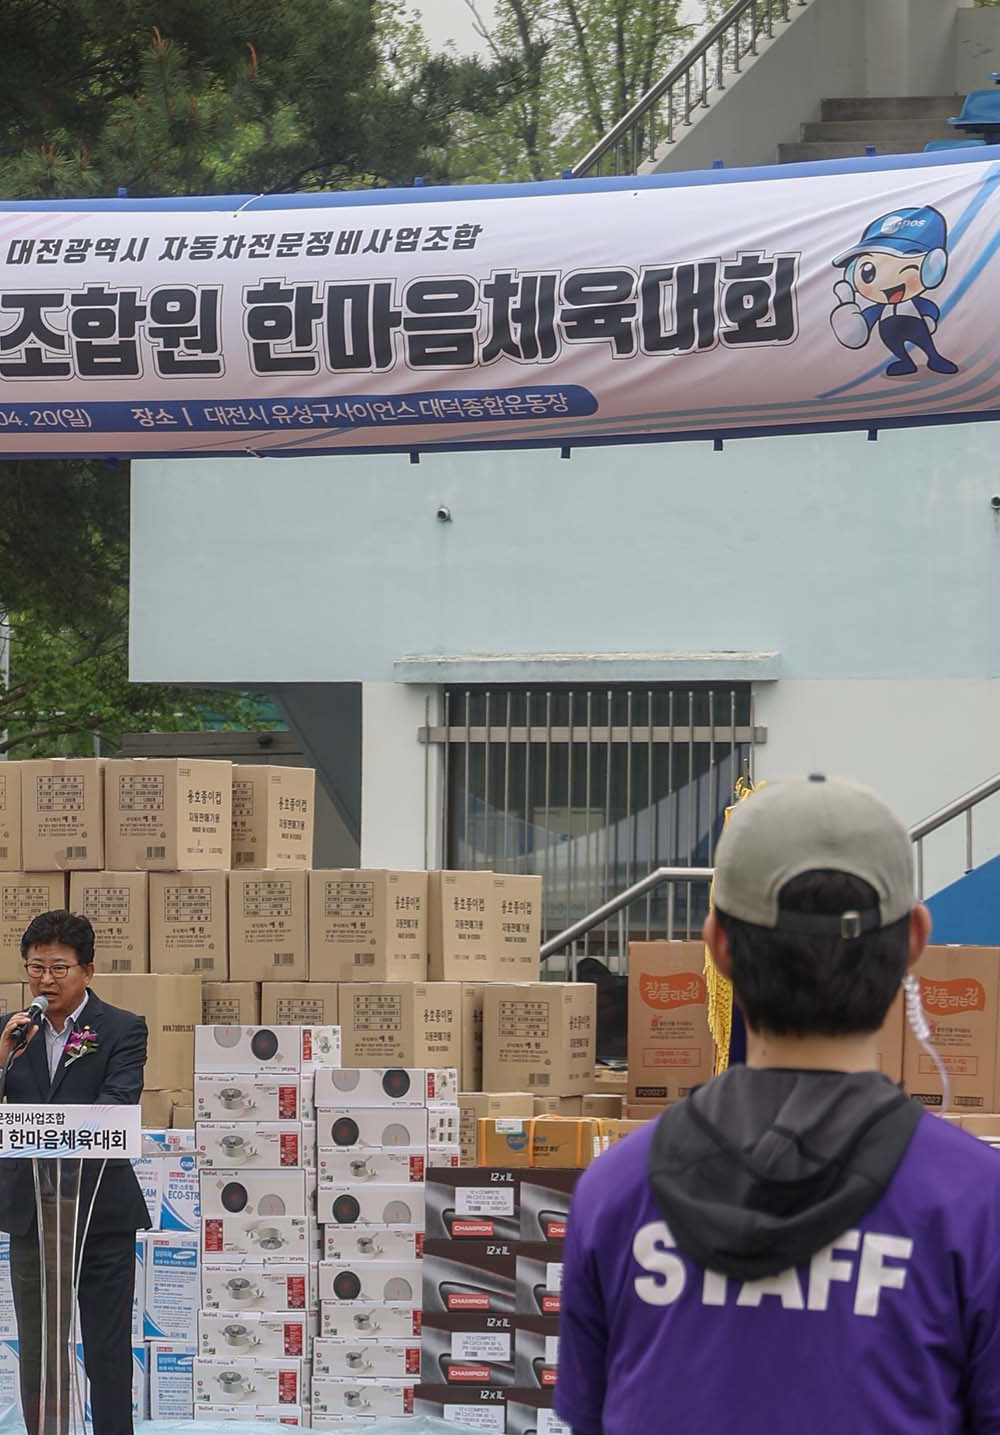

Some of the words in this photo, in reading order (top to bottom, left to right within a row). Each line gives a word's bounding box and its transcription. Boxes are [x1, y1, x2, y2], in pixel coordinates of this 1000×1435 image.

[6, 237, 149, 265] 대전광역시
[158, 223, 483, 262] 자동차전문정비사업조합
[0, 286, 220, 378] 조합원
[244, 253, 798, 376] 한마음체육대회
[131, 408, 179, 428] 장소
[204, 406, 269, 426] 대전시
[9, 1129, 128, 1151] 한마음체육대회
[453, 1225, 492, 1233] CHAMPION
[450, 1297, 489, 1305] CHAMPION
